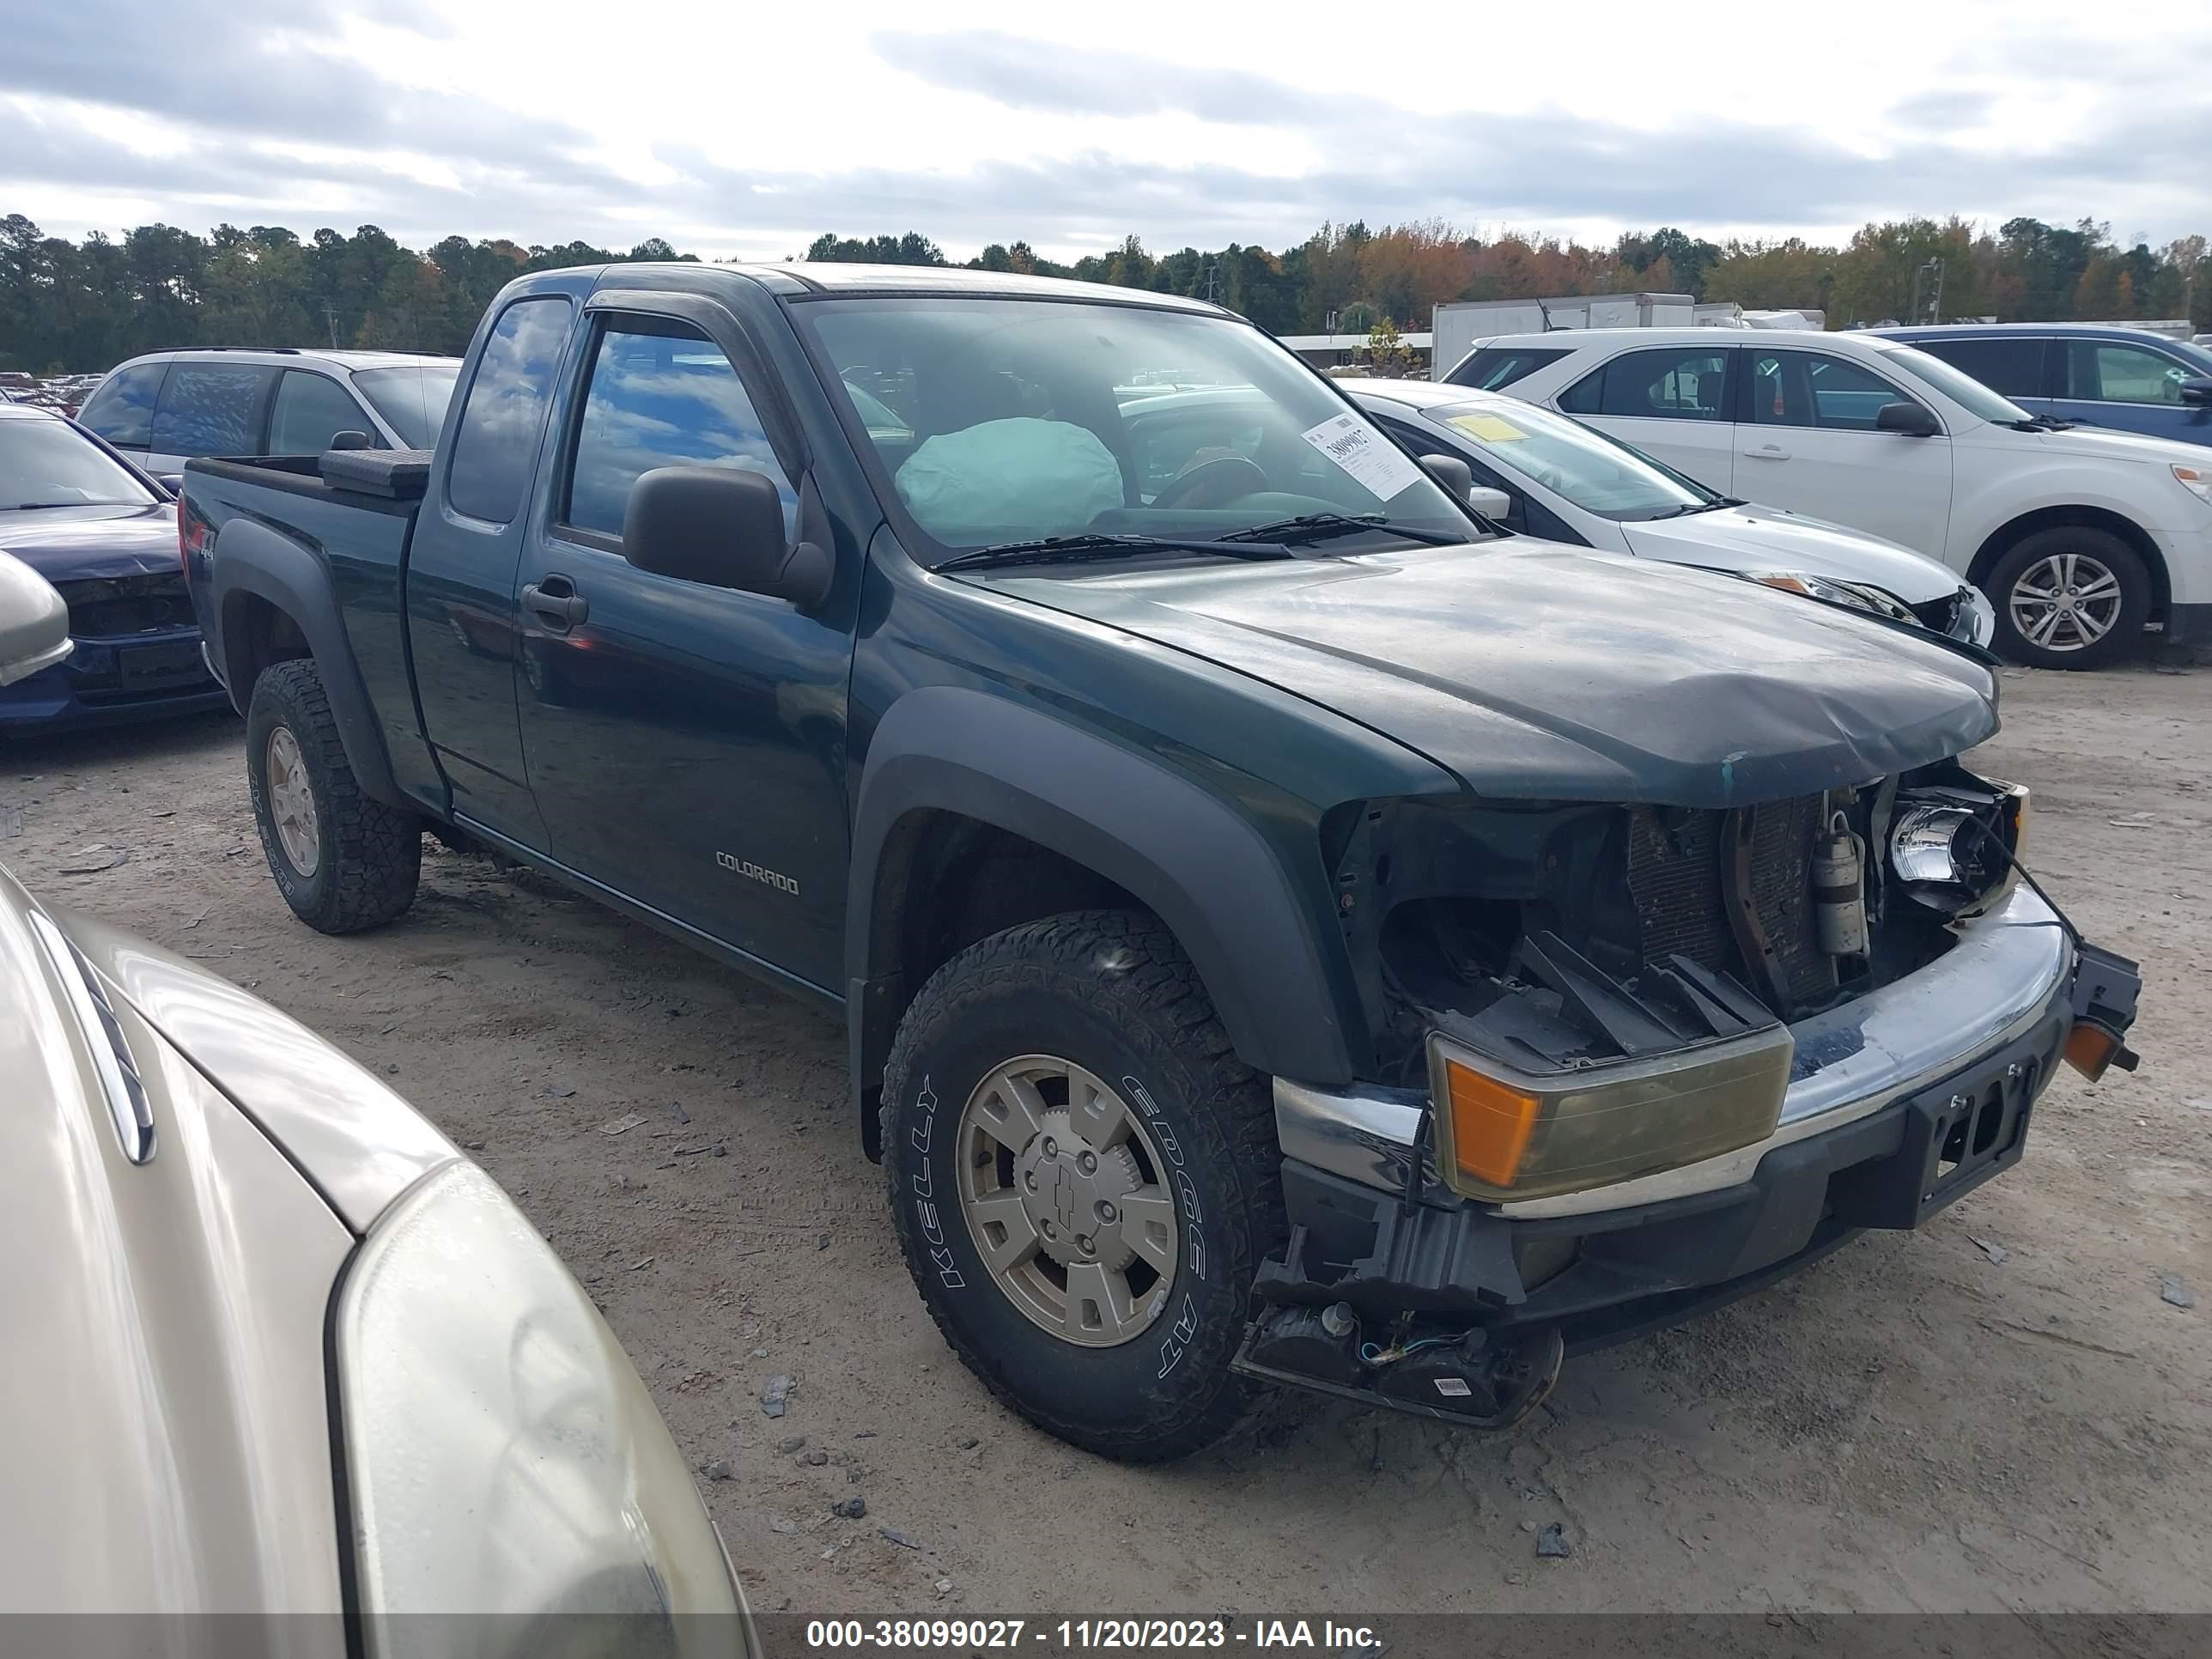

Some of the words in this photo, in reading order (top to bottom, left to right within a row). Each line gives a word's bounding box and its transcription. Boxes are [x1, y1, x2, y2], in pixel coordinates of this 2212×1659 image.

[1326, 428, 1371, 459] 38099027
[716, 851, 799, 896] COLORADO
[912, 1073, 966, 1288] KELLY
[1121, 1075, 1206, 1280] EDGE
[1158, 1291, 1198, 1379] AT
